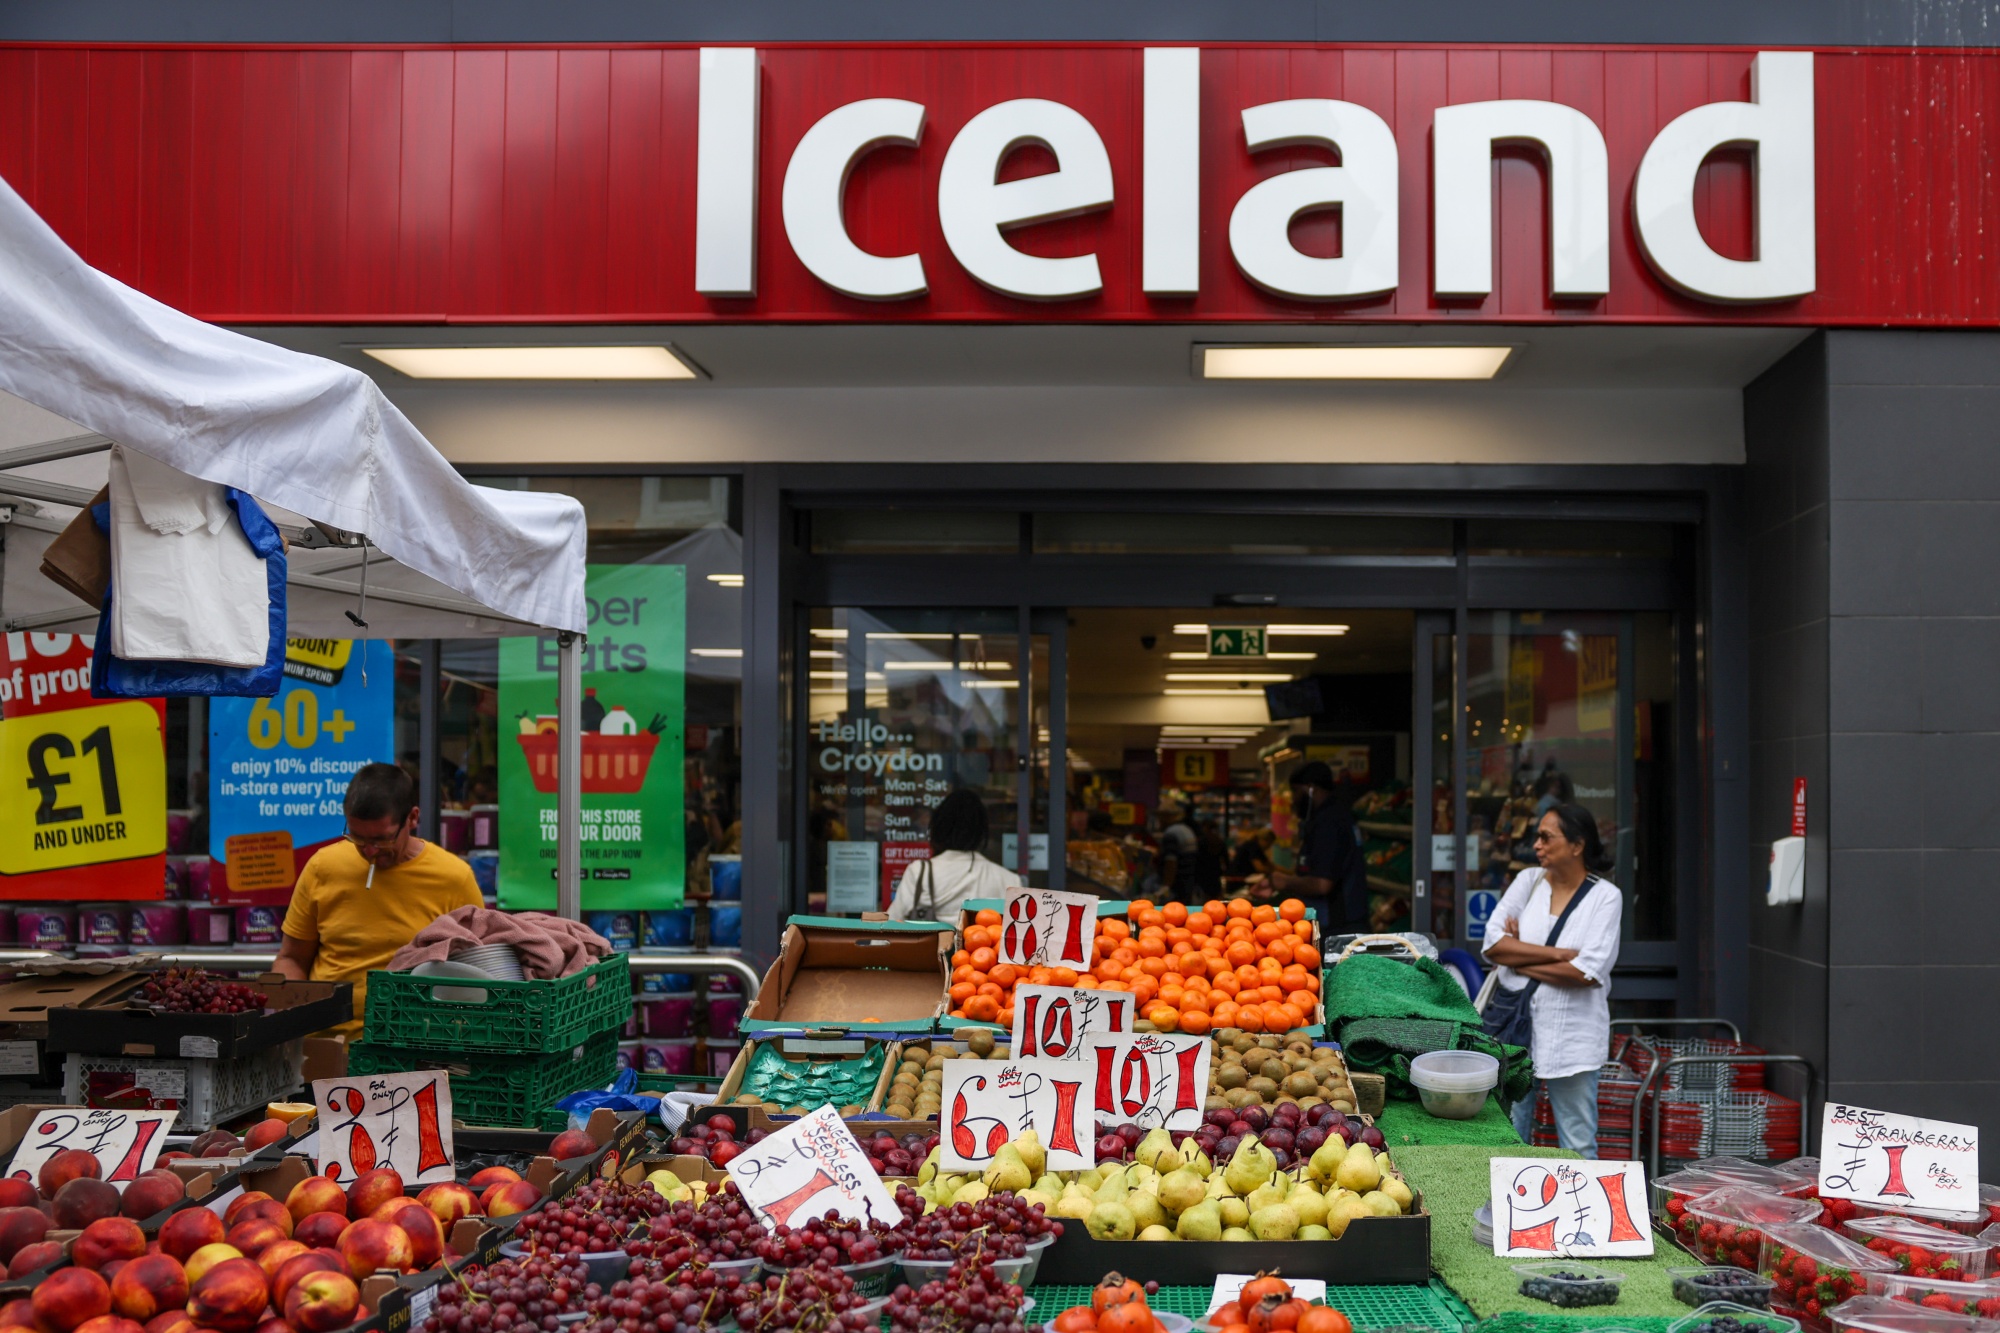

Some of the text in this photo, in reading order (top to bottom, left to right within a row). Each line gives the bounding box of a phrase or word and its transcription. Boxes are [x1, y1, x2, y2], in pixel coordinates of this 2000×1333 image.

[695, 46, 1816, 302] Iceland
[30, 657, 93, 705] prod
[305, 667, 334, 683] SPEND
[247, 688, 355, 749] 60+
[820, 718, 913, 742] Hello...
[232, 758, 271, 778] enjoy
[275, 758, 306, 774] 10%
[820, 747, 943, 777] Croydon
[26, 725, 122, 826] £1
[885, 779, 916, 791] Mon
[925, 779, 947, 791] Sat
[221, 779, 349, 799] in-store every Tue
[850, 786, 877, 797] open
[259, 800, 280, 816] for
[284, 802, 315, 816] over
[885, 794, 914, 806] 8am
[923, 794, 946, 808] 9p
[604, 809, 642, 823] STORE
[885, 814, 910, 826] Sun
[34, 821, 127, 851] AND UNDER
[540, 825, 558, 841] TO
[602, 825, 642, 841] DOOR
[885, 829, 917, 842] 11am
[585, 848, 600, 859] THE
[602, 848, 619, 859] APP
[622, 848, 642, 859] NOW
[885, 848, 931, 858] GIFT CARDS
[1005, 894, 1037, 965] 8
[1020, 995, 1073, 1058] 10
[369, 1080, 386, 1091] FOR
[1094, 1046, 1150, 1118] 10
[371, 1089, 394, 1100] ONLY
[82, 1117, 112, 1126] ONLY
[88, 1110, 112, 1118] FOR
[952, 1075, 1009, 1161] 6
[1834, 1105, 1885, 1125] BEST
[326, 1086, 376, 1183] 3
[619, 1117, 646, 1150] FENIX FRESH
[820, 1112, 861, 1153] SWEET
[1856, 1122, 1976, 1152] STRAWBERRY
[808, 1126, 862, 1191] SEEDLESS
[1825, 1137, 1915, 1200] £1
[1507, 1165, 1560, 1252] 2
